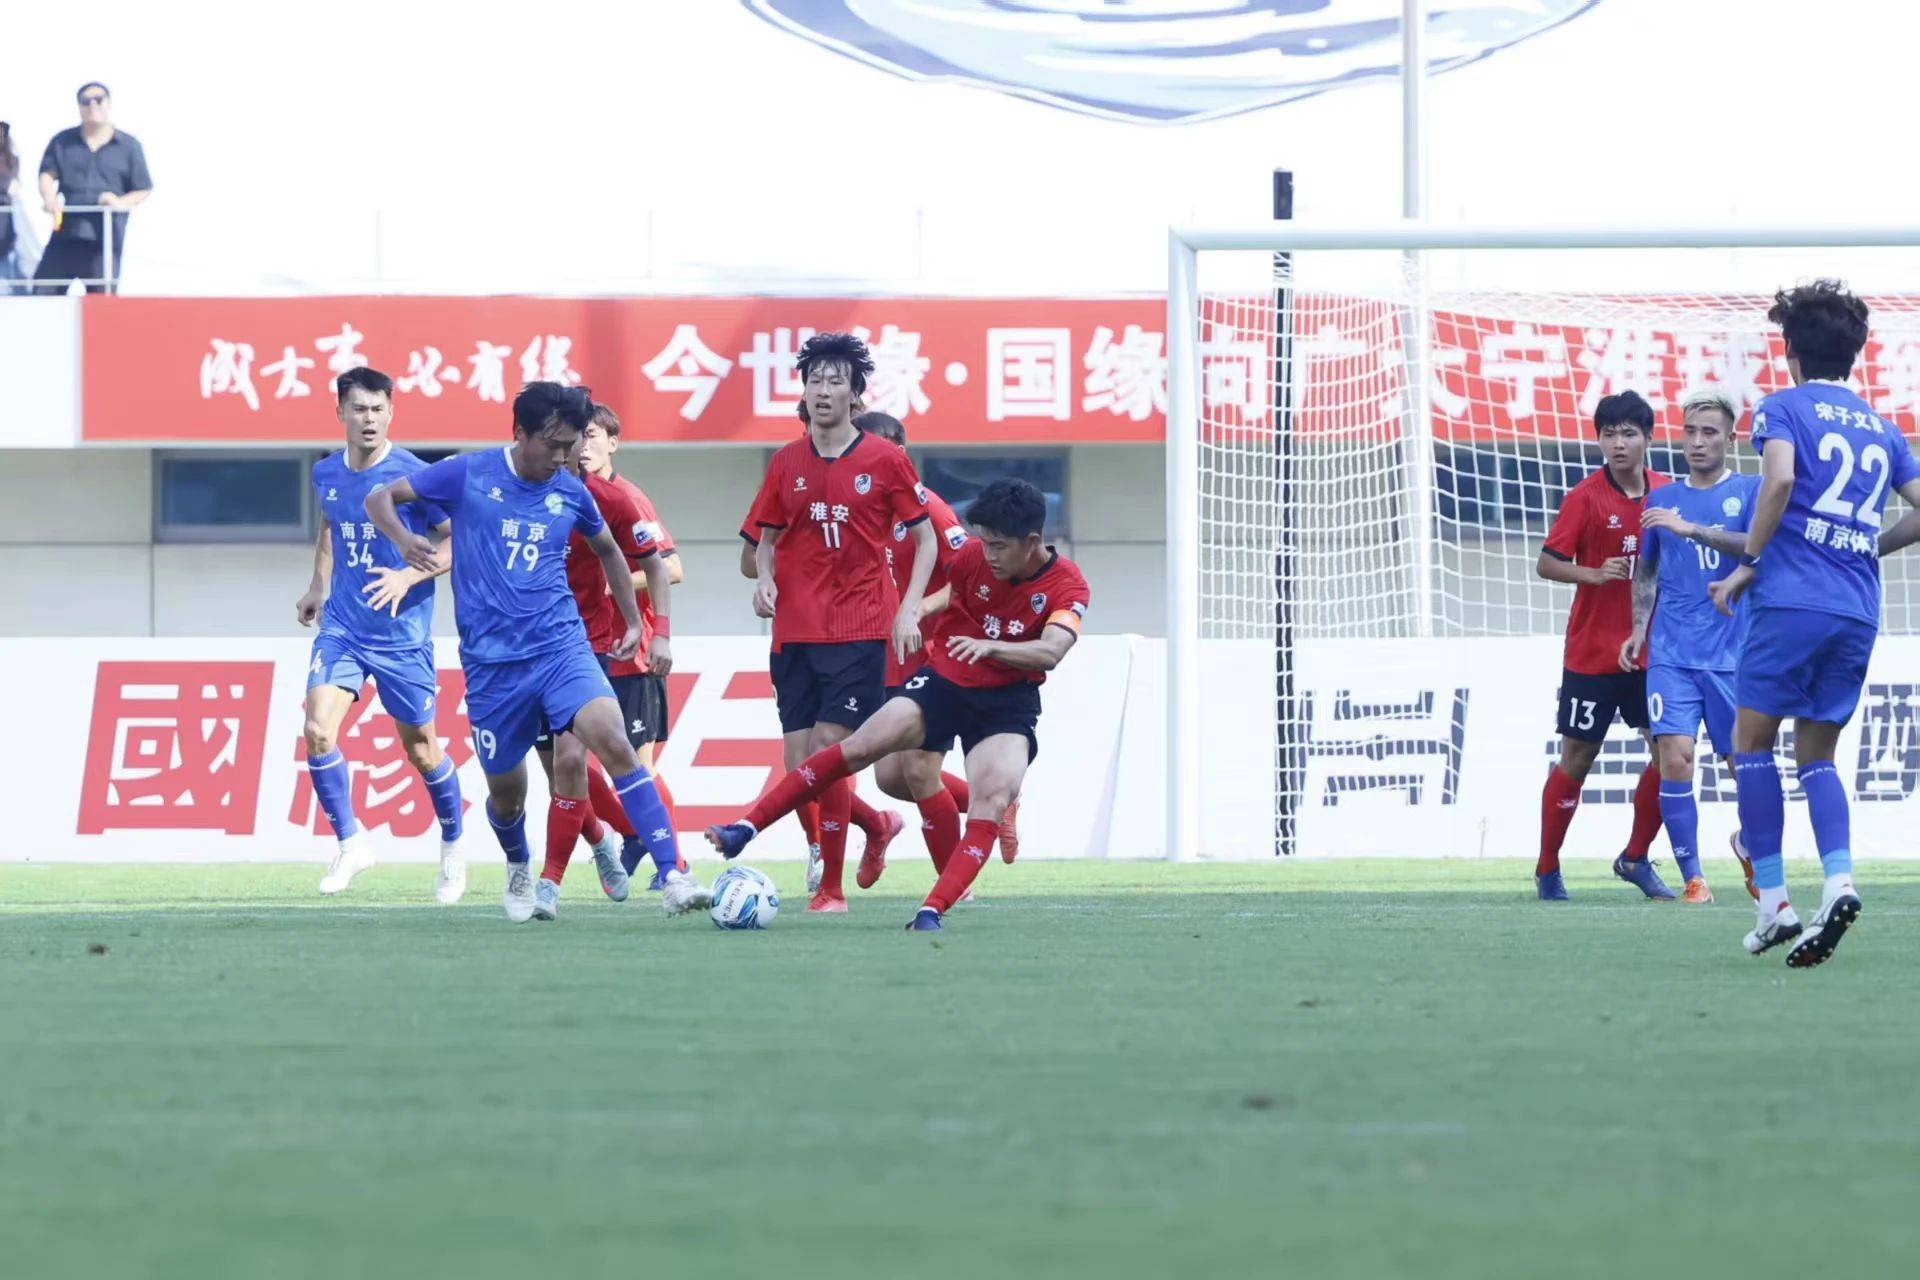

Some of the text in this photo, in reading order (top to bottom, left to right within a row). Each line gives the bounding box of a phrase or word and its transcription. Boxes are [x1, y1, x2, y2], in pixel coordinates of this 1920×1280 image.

[1812, 432, 1889, 528] 22
[809, 501, 849, 523] 淮安
[340, 521, 378, 540] 南京
[501, 518, 547, 542] 南京
[821, 522, 841, 549] 11
[346, 542, 375, 569] 34
[505, 541, 541, 571] 79
[1695, 544, 1720, 570] 10
[1569, 697, 1597, 731] 13
